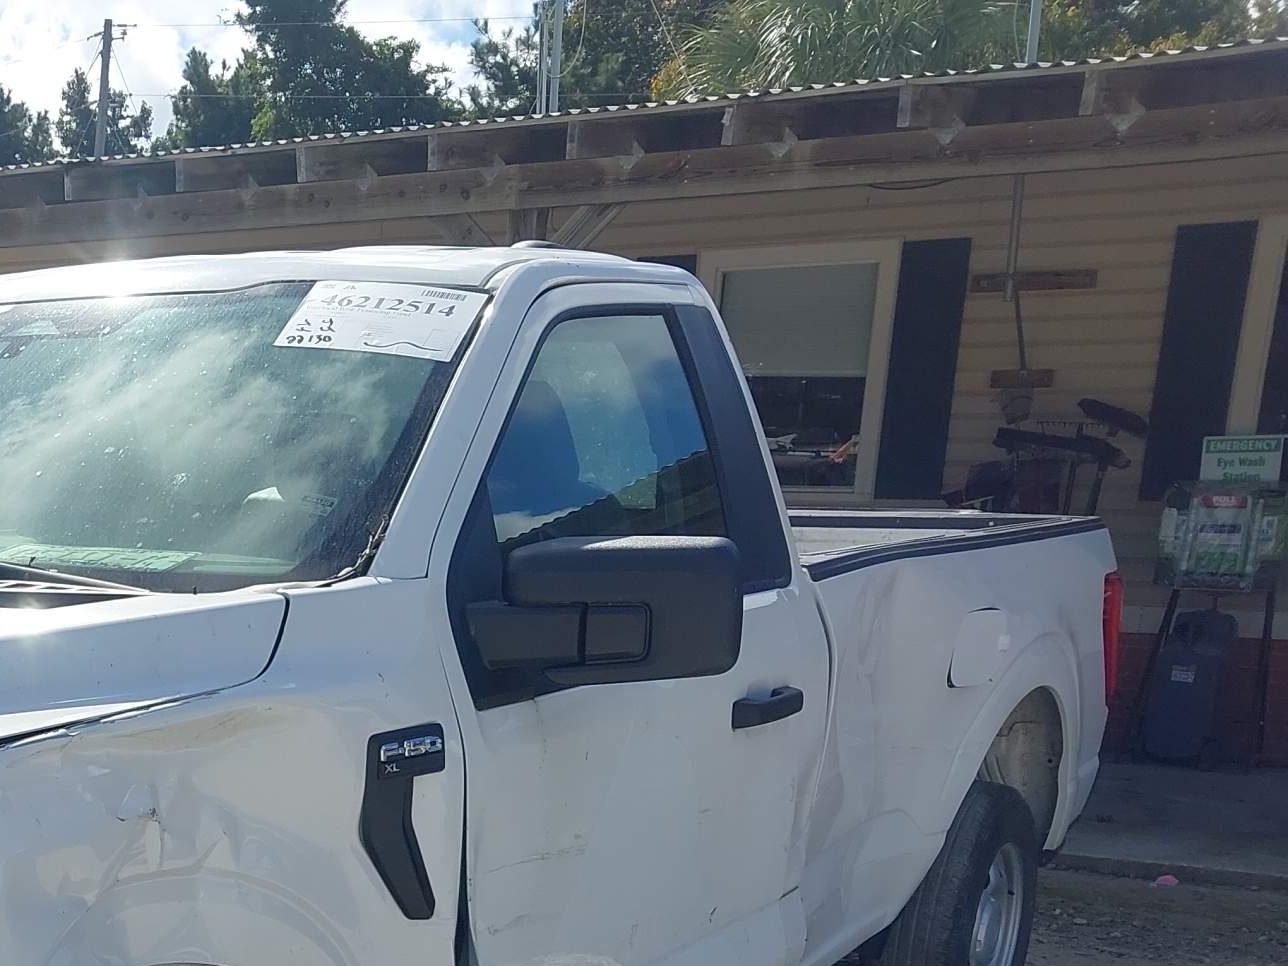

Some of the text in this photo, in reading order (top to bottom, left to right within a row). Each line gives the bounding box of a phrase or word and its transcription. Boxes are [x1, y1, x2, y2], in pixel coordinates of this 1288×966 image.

[321, 293, 457, 318] 46212514
[1209, 439, 1279, 452] EMERGENCY
[1217, 456, 1265, 470] Eye Wash
[380, 735, 444, 762] F-150
[384, 762, 400, 775] XL
